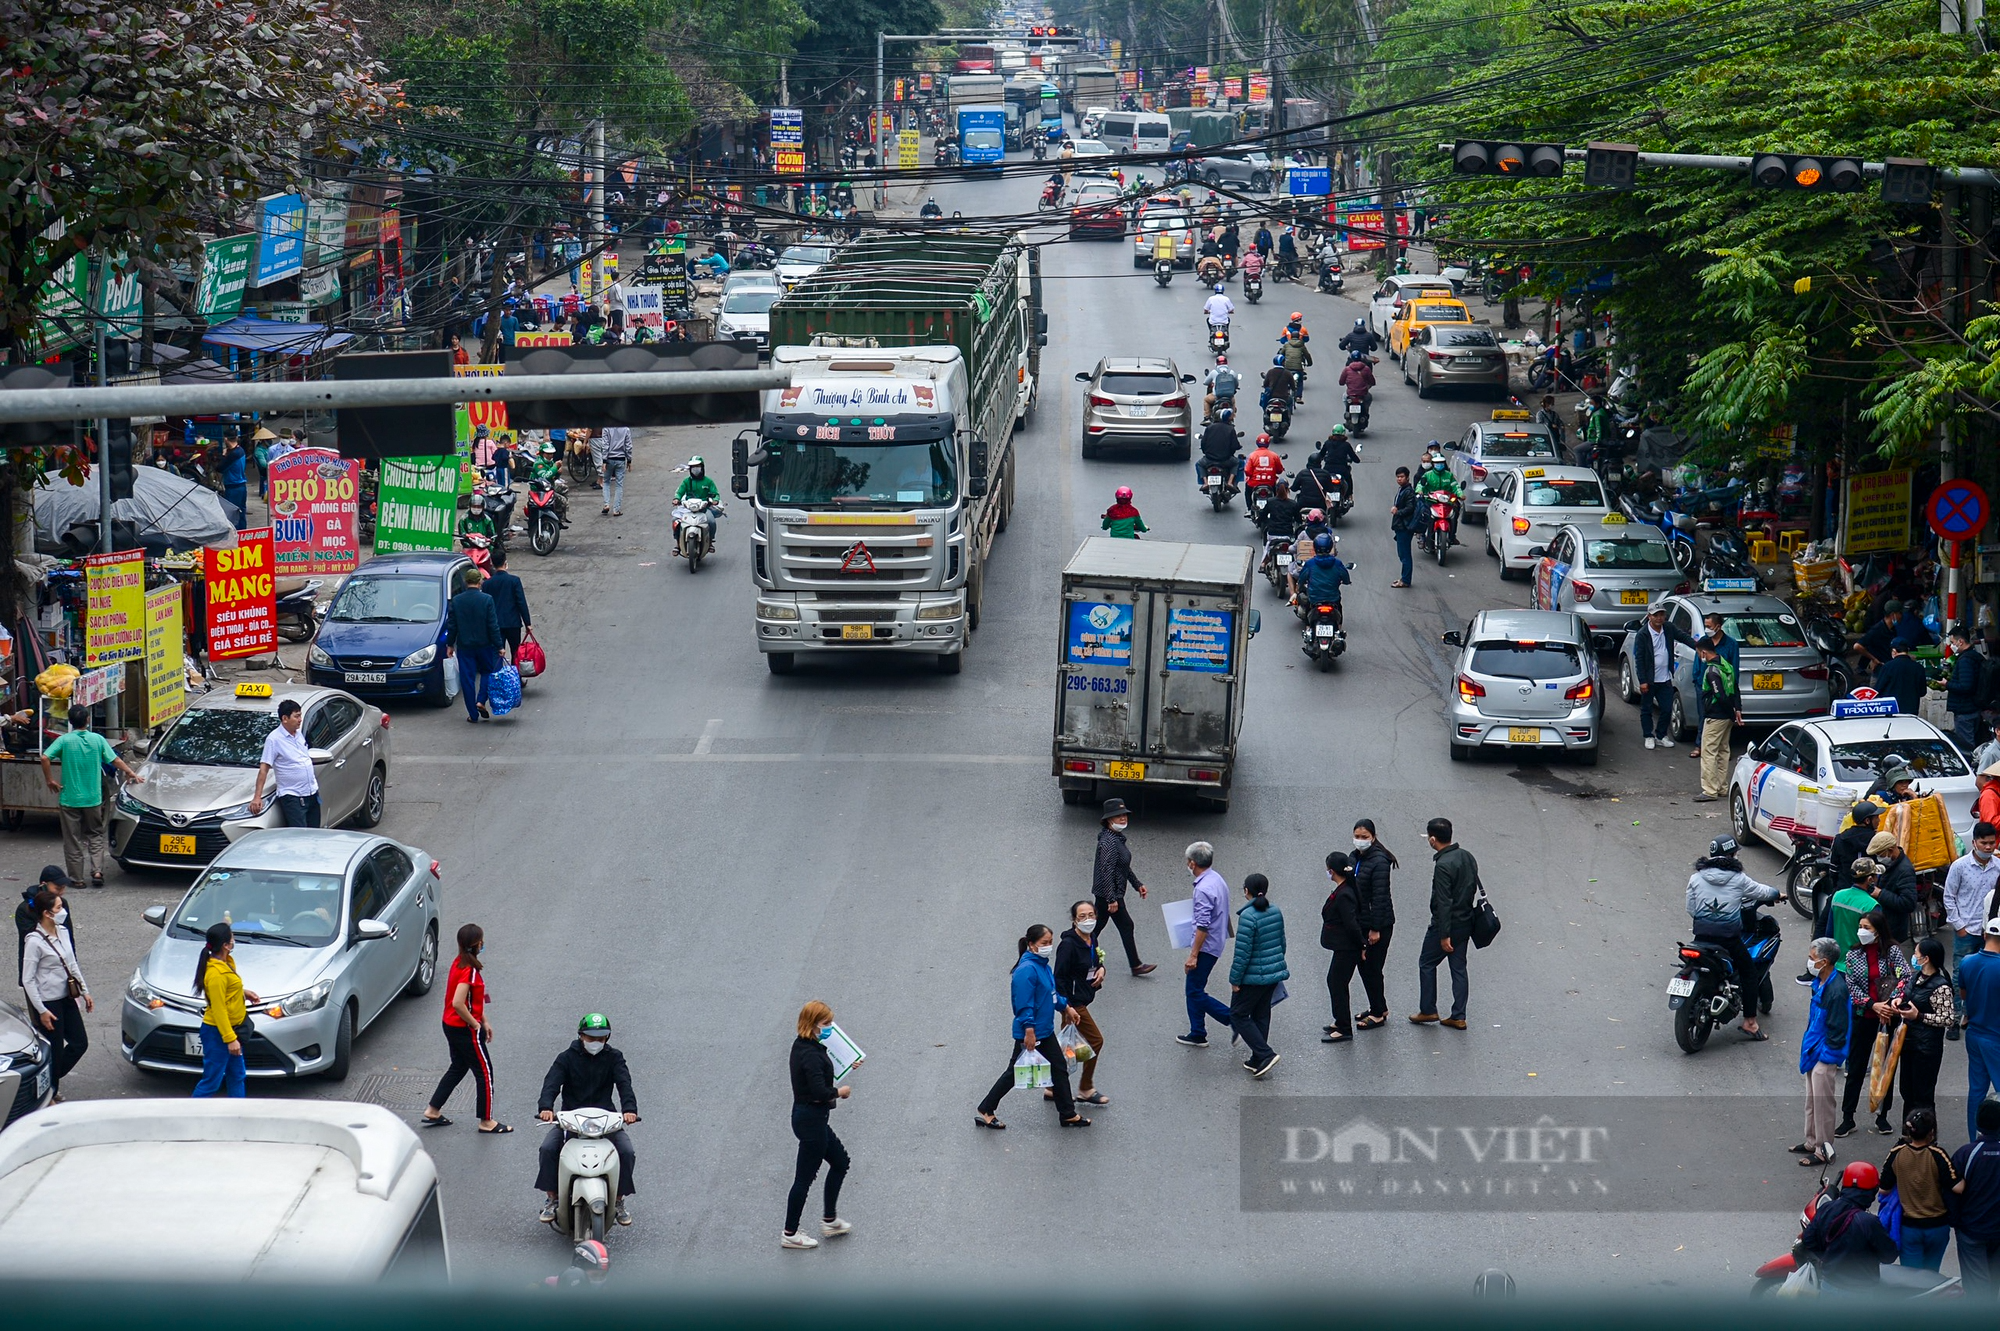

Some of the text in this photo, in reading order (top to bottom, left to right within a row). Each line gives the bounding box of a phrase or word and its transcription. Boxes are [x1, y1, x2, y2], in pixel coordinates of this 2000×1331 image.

[626, 292, 640, 310] NHÀ
[640, 289, 659, 308] THUỐC
[813, 387, 908, 408] Thượng Lộ Bình An
[332, 458, 351, 471] MINH
[384, 458, 417, 490] CHUYÊN
[437, 466, 456, 494] CHO
[273, 470, 354, 502] PHỞ BÒ
[311, 501, 339, 514] MÓNG
[381, 498, 451, 534] BỆNH NHÂN K
[275, 514, 307, 542] BÚN
[326, 518, 342, 530] GÀ
[322, 536, 346, 548] MỌC
[392, 542, 412, 552] 0984
[216, 544, 263, 572] SIM
[276, 548, 354, 562] MIẾN NGAN
[274, 564, 289, 574] CƠM
[290, 564, 308, 574] RANG
[313, 562, 327, 572] PHỞ
[208, 574, 272, 608] MẠNG
[1726, 580, 1740, 588] SÔNG
[216, 606, 268, 624] SIÊU KHỦNG
[210, 626, 226, 638] ĐIỆN
[226, 624, 244, 635] THOẠI
[214, 630, 272, 650] GIÁ SIÊU RẺ
[240, 684, 264, 692] TAXI
[1067, 675, 1127, 694] 29C-663.39
[1120, 762, 1135, 771] 29C
[170, 836, 185, 844] 29E
[164, 844, 191, 853] 025.74
